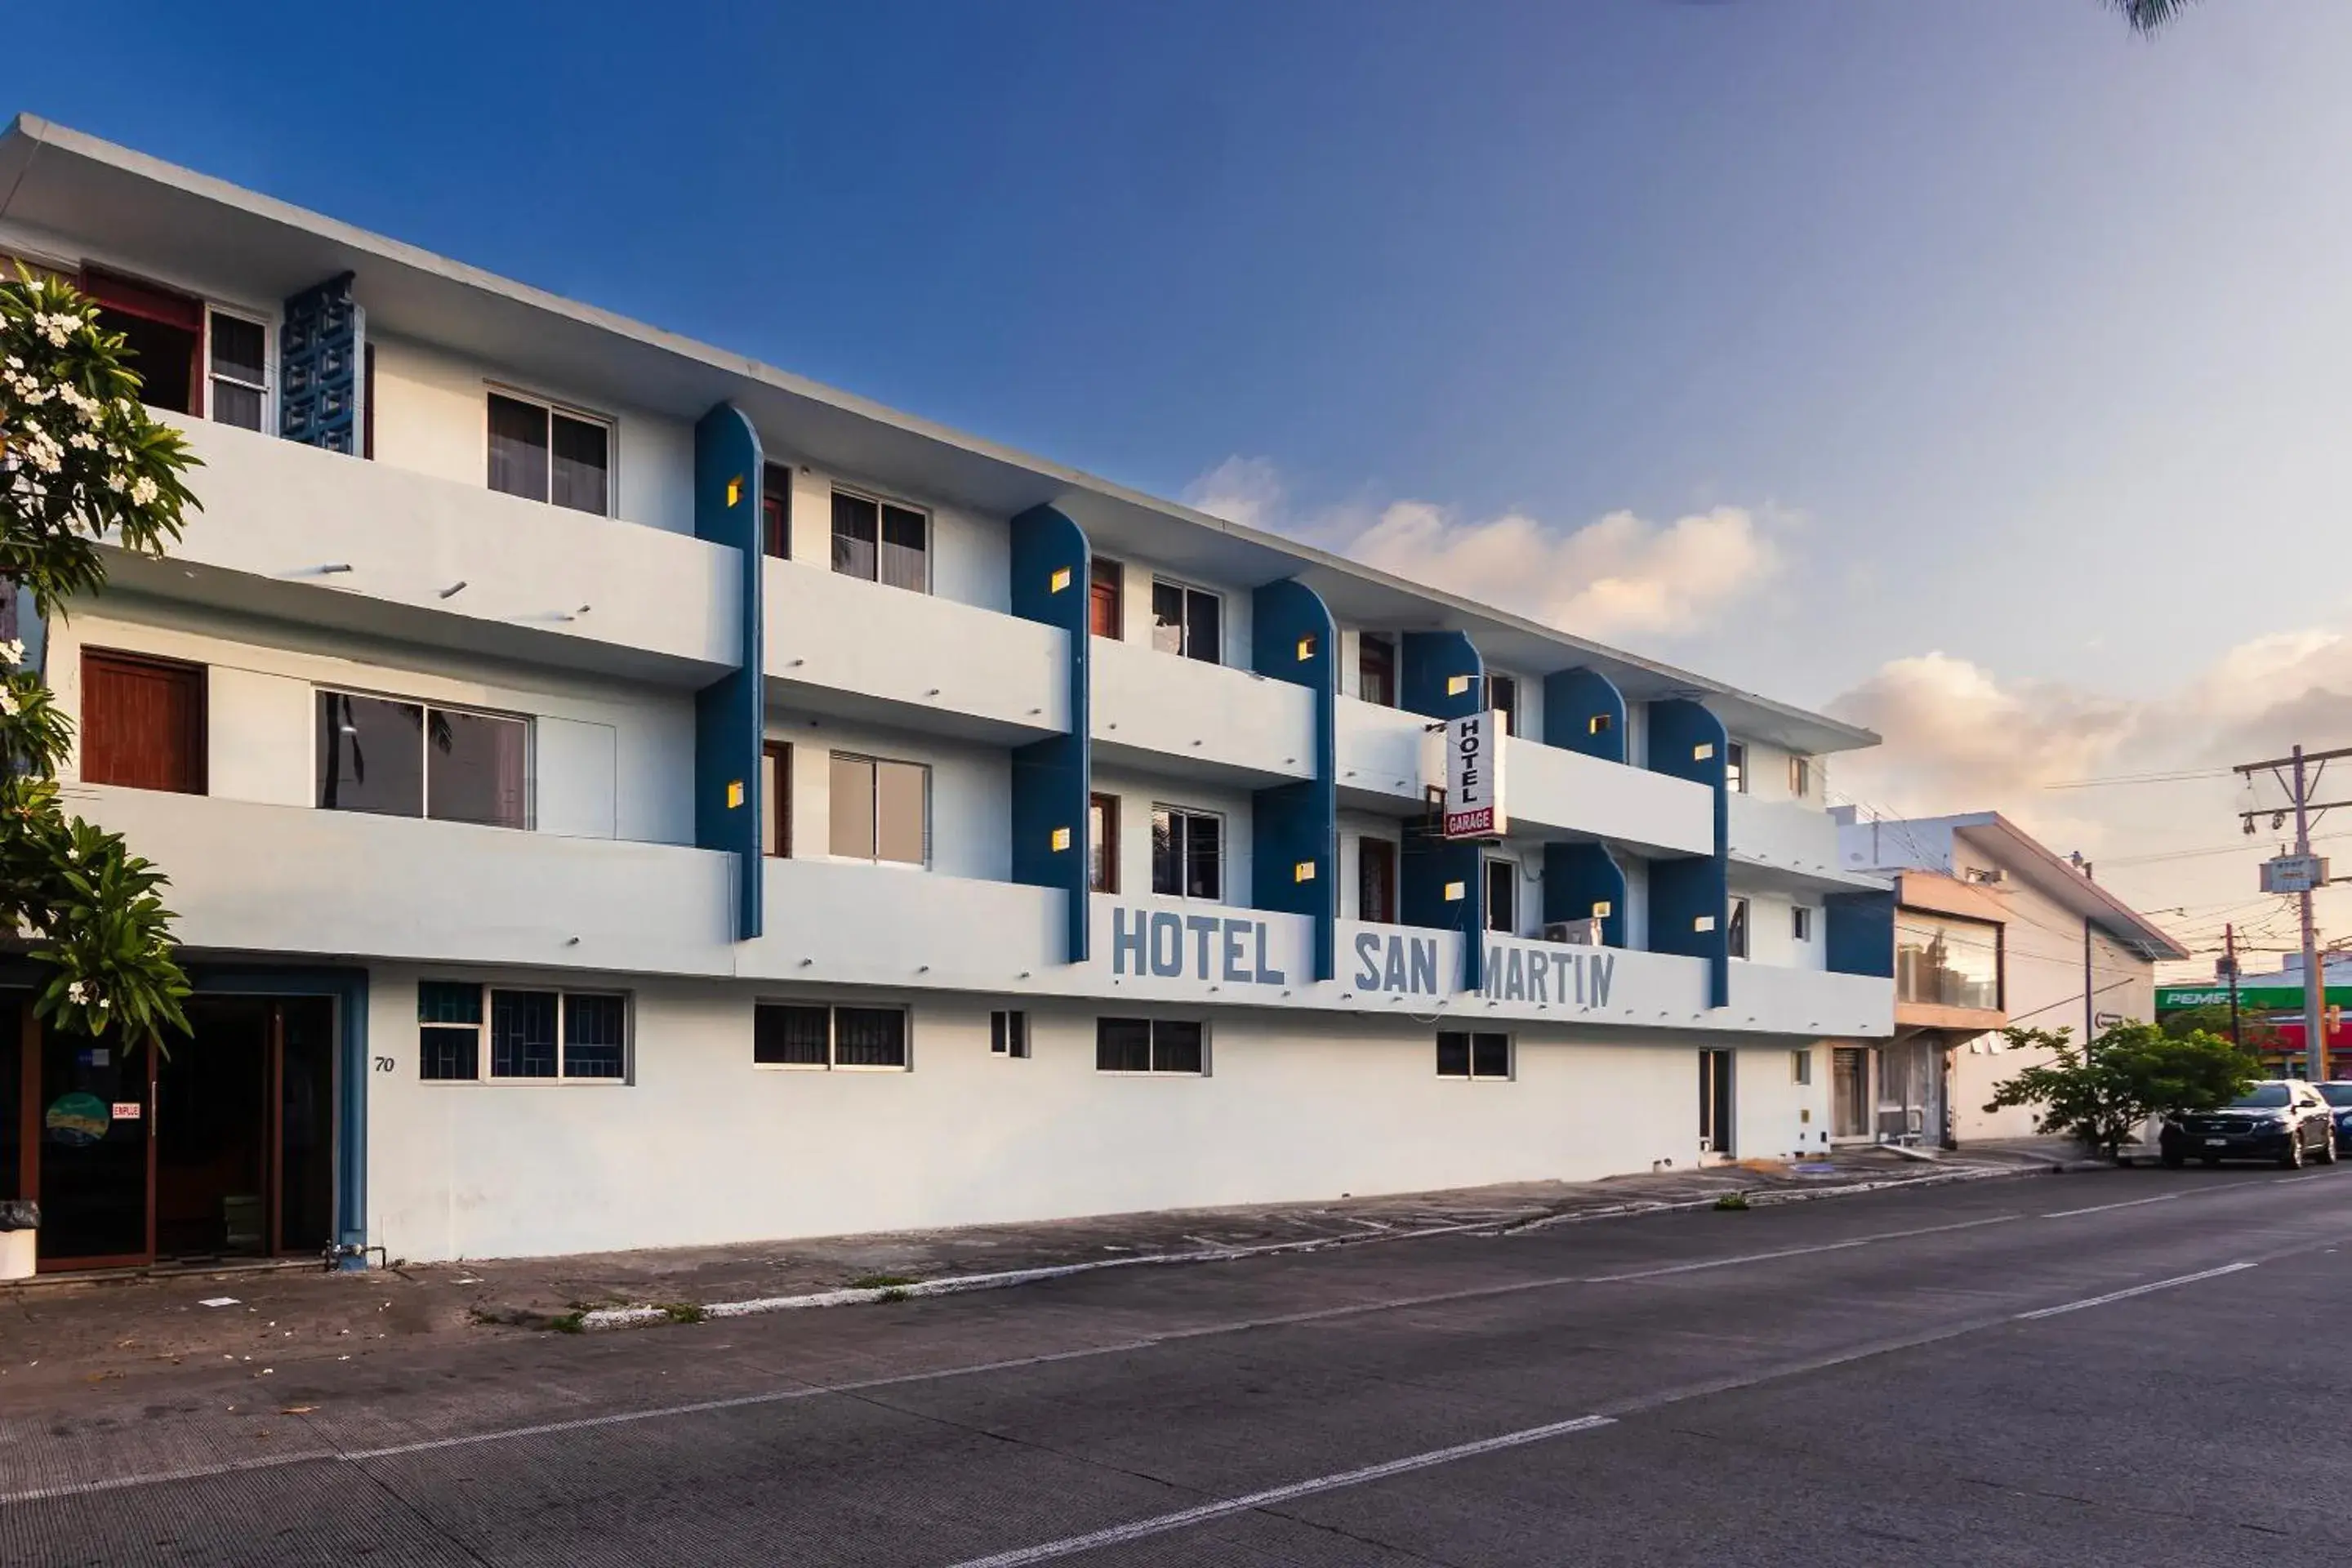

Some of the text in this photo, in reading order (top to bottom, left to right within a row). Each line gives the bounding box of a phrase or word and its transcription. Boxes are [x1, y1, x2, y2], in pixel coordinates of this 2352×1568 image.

[1459, 719, 1479, 804] HOTEL
[1449, 811, 1490, 832] GARAGE
[1112, 907, 1615, 1009] HOTEL SAN MARTIN
[375, 1057, 394, 1071] 70
